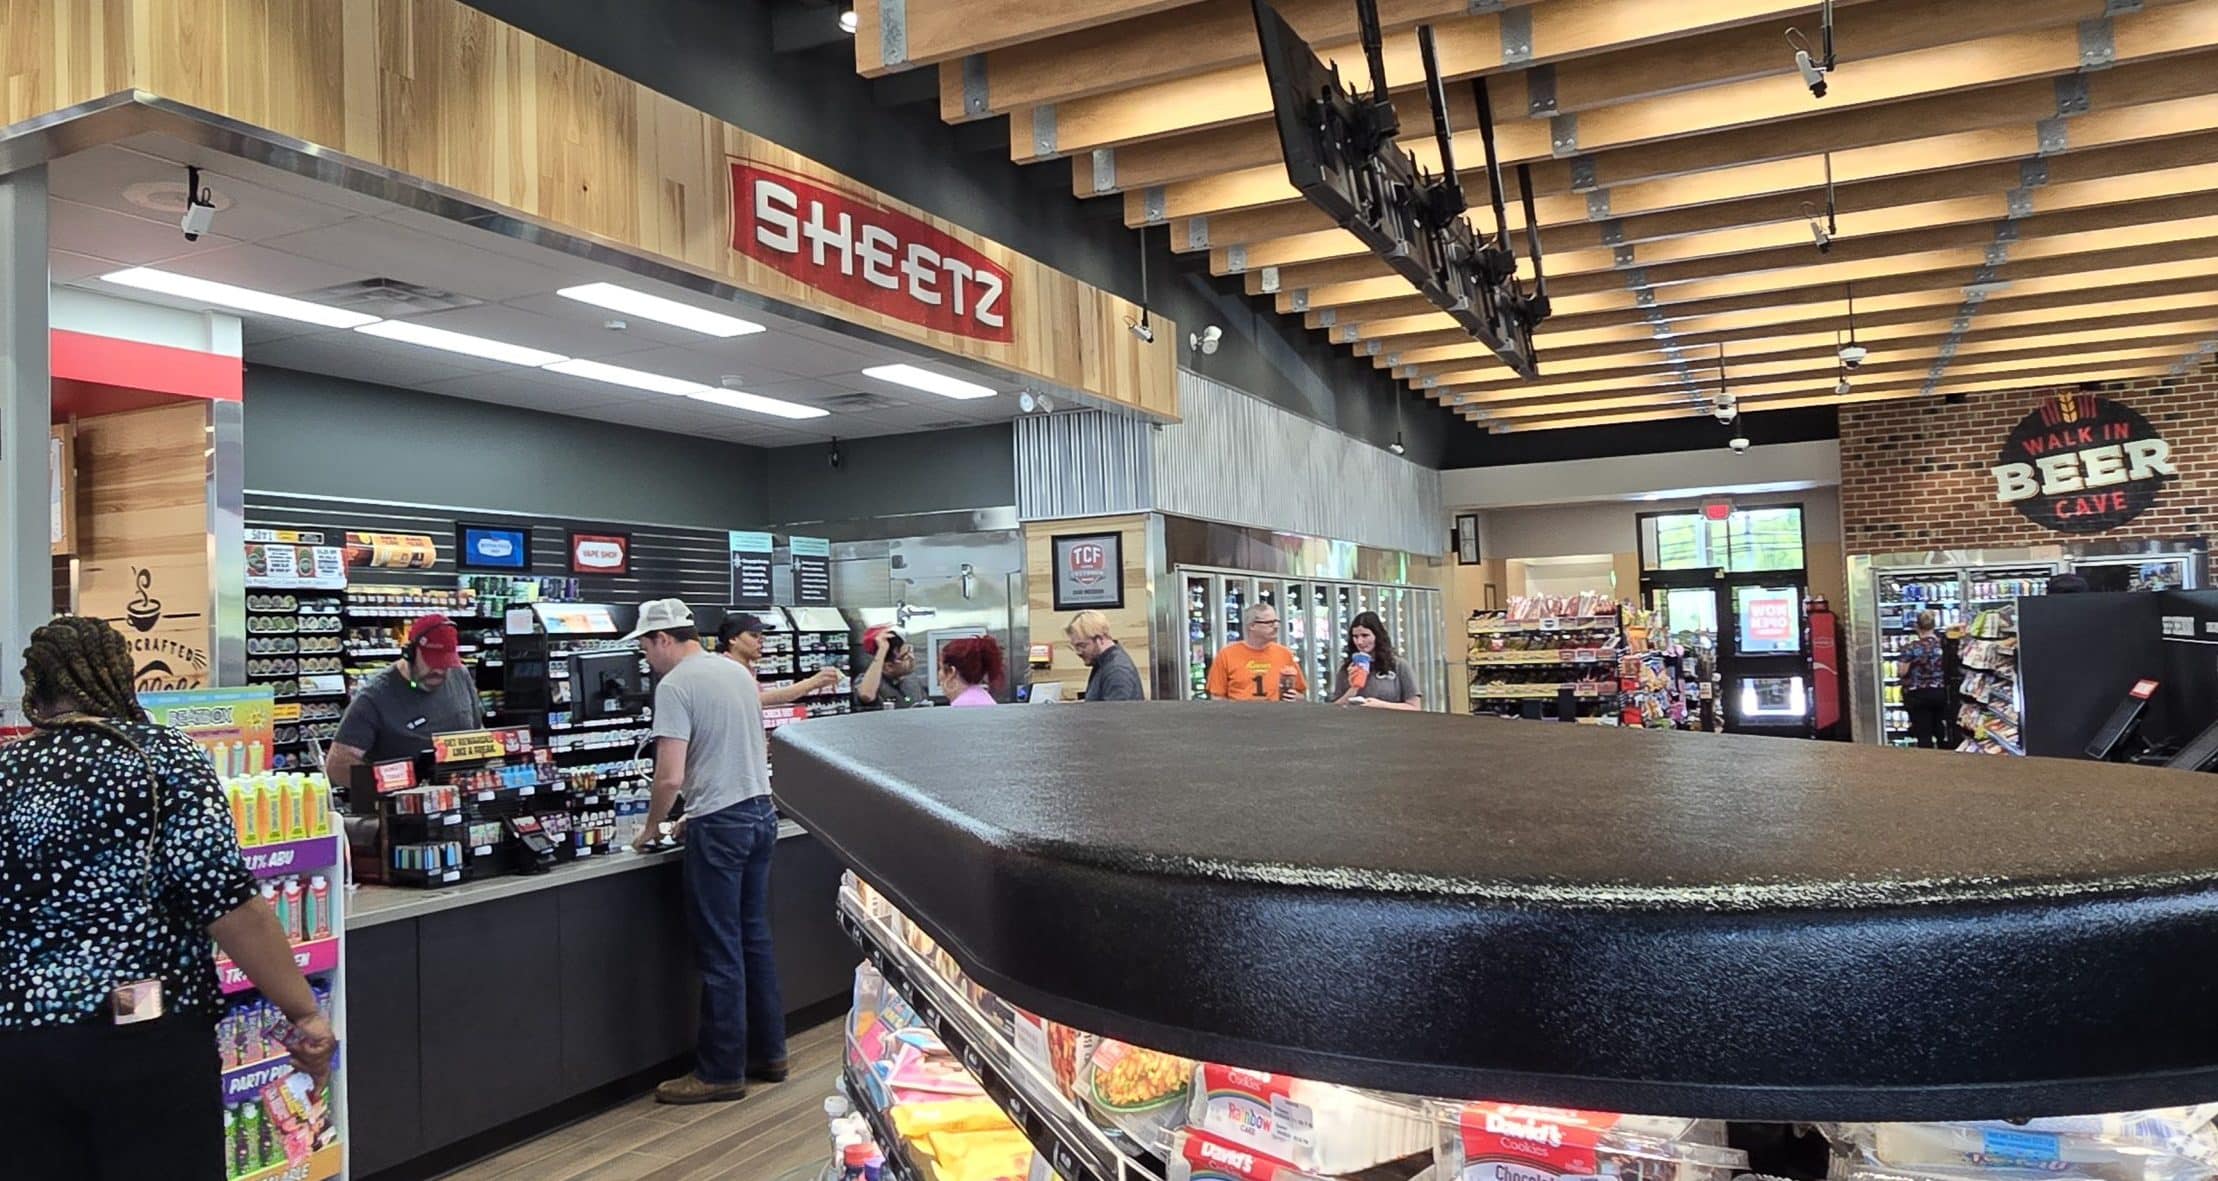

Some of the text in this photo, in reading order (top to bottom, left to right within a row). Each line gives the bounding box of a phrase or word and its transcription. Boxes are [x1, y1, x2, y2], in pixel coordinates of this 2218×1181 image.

[755, 180, 1004, 328] SHEETZ
[2022, 422, 2129, 456] WALK IN
[1990, 438, 2177, 501] BEER
[2055, 491, 2128, 519] CAVE
[601, 550, 617, 559] SHOP
[1073, 546, 1101, 565] TCF
[1252, 675, 1268, 697] 1
[229, 1069, 270, 1095] PARTY
[1228, 1102, 1273, 1132] Rainbow
[1485, 1111, 1562, 1147] David's
[1500, 1137, 1549, 1157] Cookies
